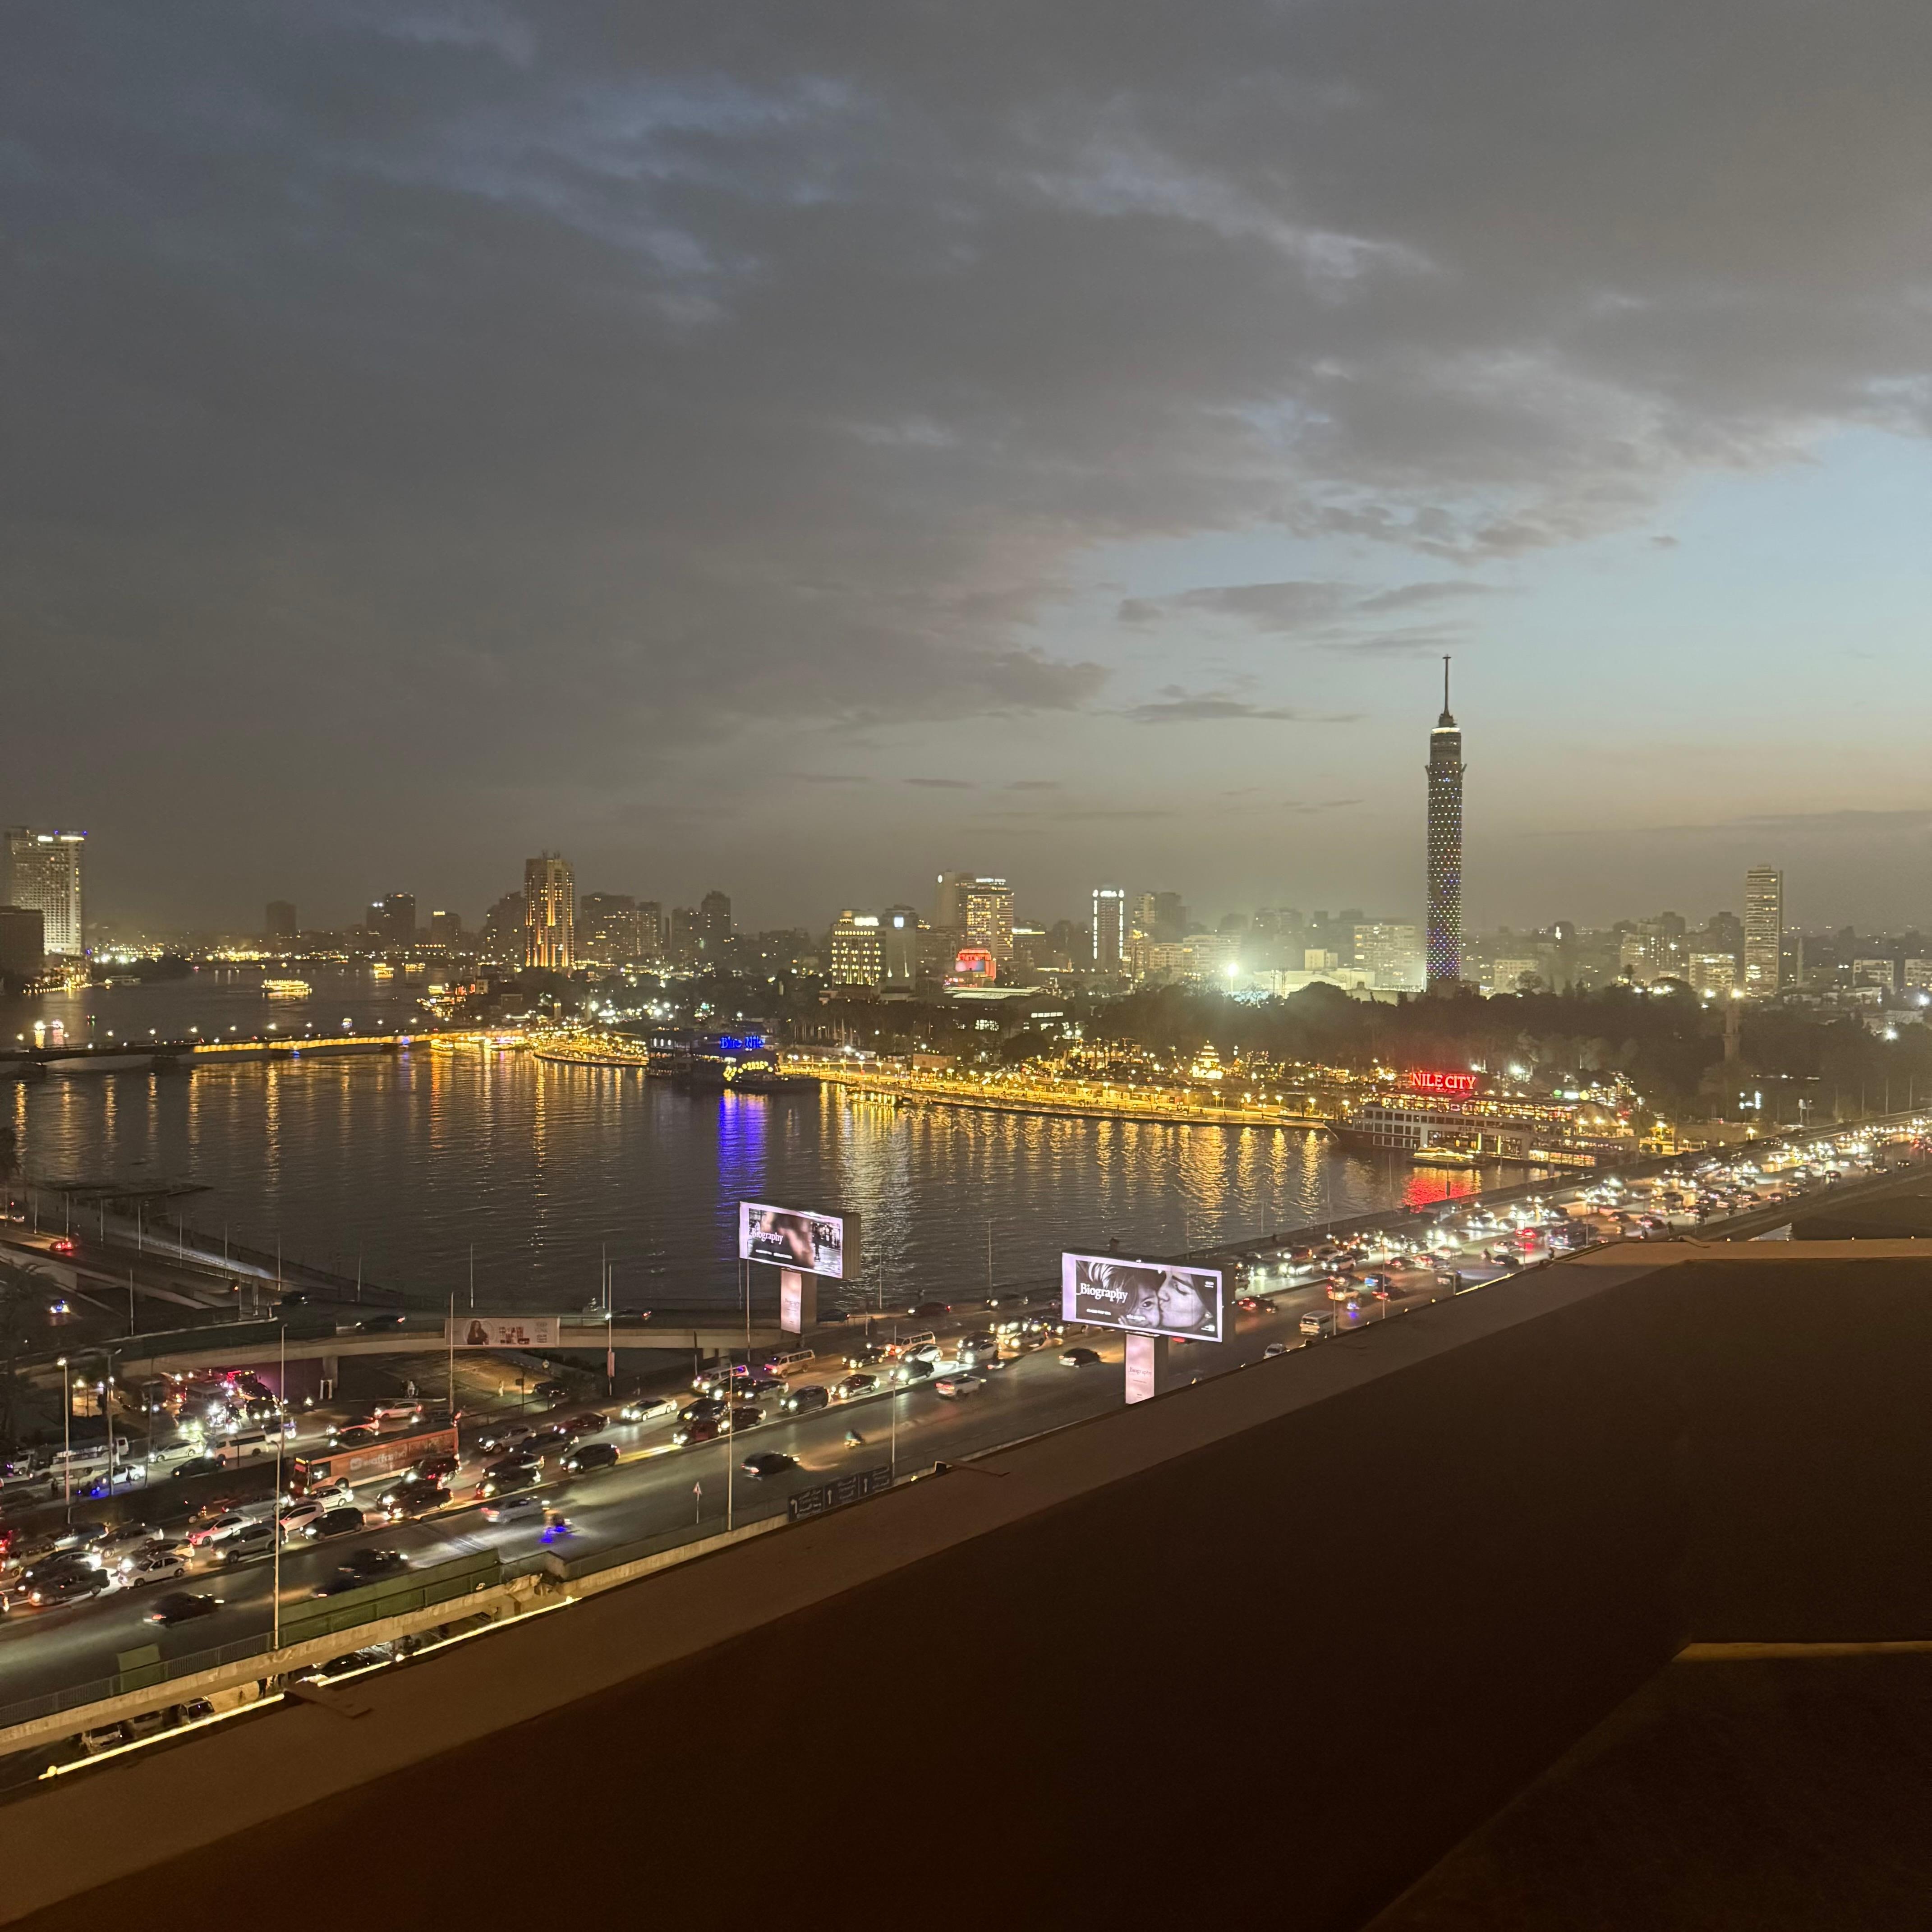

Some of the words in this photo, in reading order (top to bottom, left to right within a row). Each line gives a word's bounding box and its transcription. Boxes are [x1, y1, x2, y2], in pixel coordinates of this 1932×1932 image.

[721, 1036, 742, 1049] Blue
[745, 1036, 765, 1048] Nile
[747, 1061, 765, 1070] 2026
[1412, 1073, 1444, 1087] NILE
[1444, 1076, 1477, 1090] CITY
[1080, 1283, 1128, 1303] Biography
